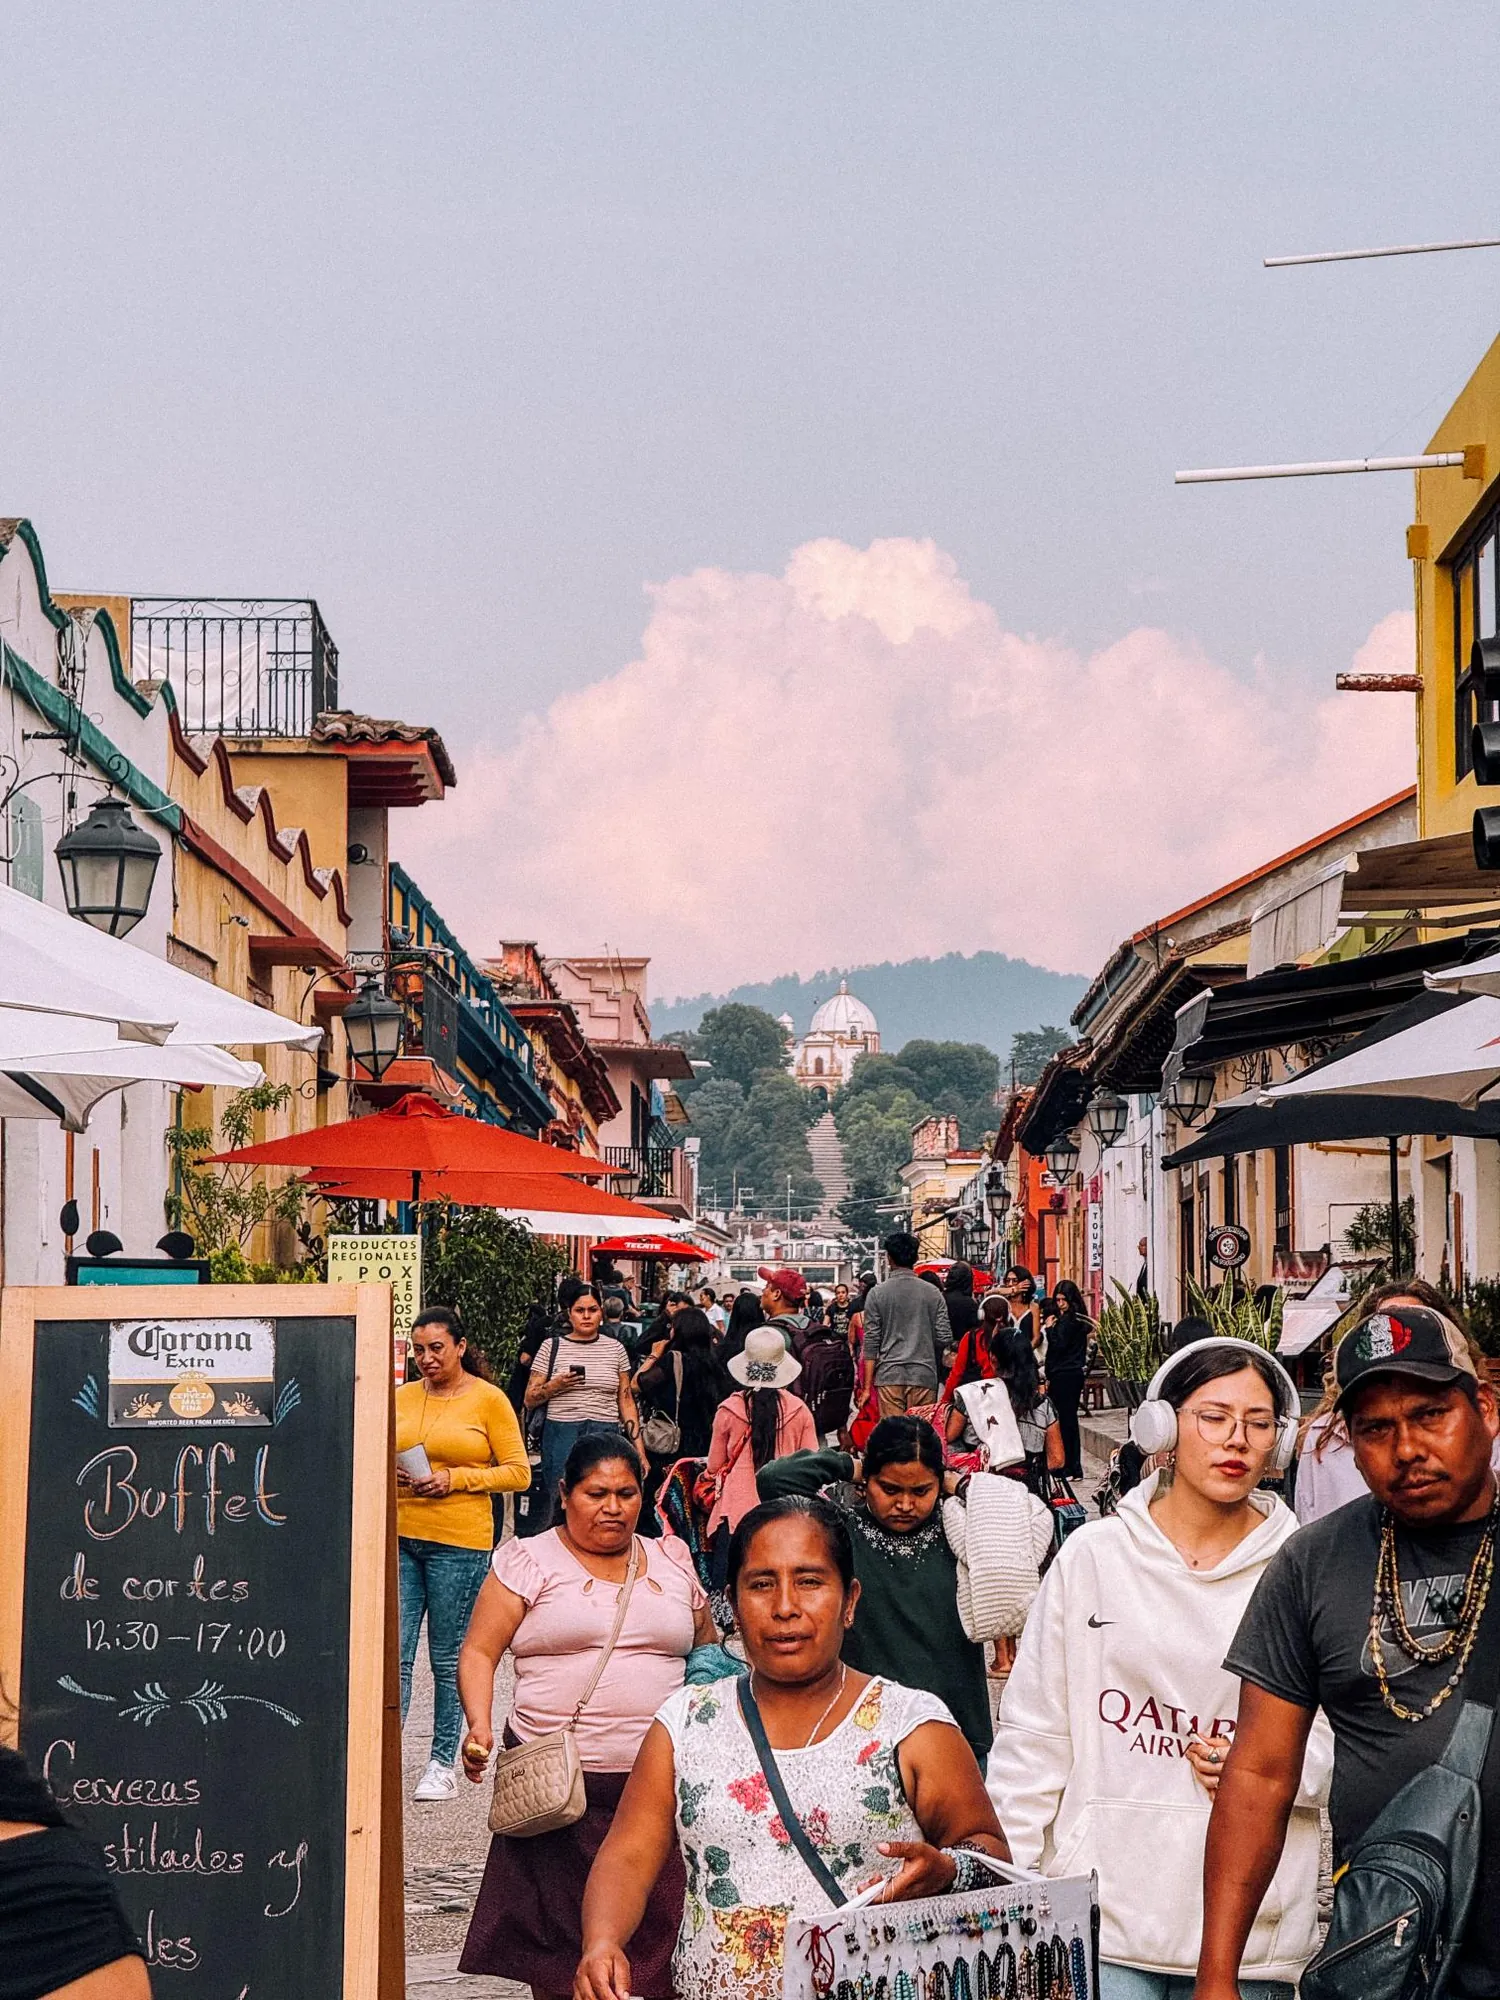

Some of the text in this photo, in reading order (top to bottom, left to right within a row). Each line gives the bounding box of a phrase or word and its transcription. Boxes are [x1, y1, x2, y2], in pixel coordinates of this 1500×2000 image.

[331, 1240, 417, 1250] PRODUCTOS
[331, 1252, 417, 1261] REGIONALES
[623, 1242, 664, 1250] TECATE
[359, 1266, 412, 1279] POX
[128, 1325, 253, 1360] Corona
[165, 1353, 215, 1368] Extra
[76, 1441, 288, 1540] Buffet
[60, 1551, 249, 1602] de cortes
[42, 1739, 201, 1803] Cervezas
[103, 1821, 245, 1870] stilados
[137, 1909, 200, 1964] les
